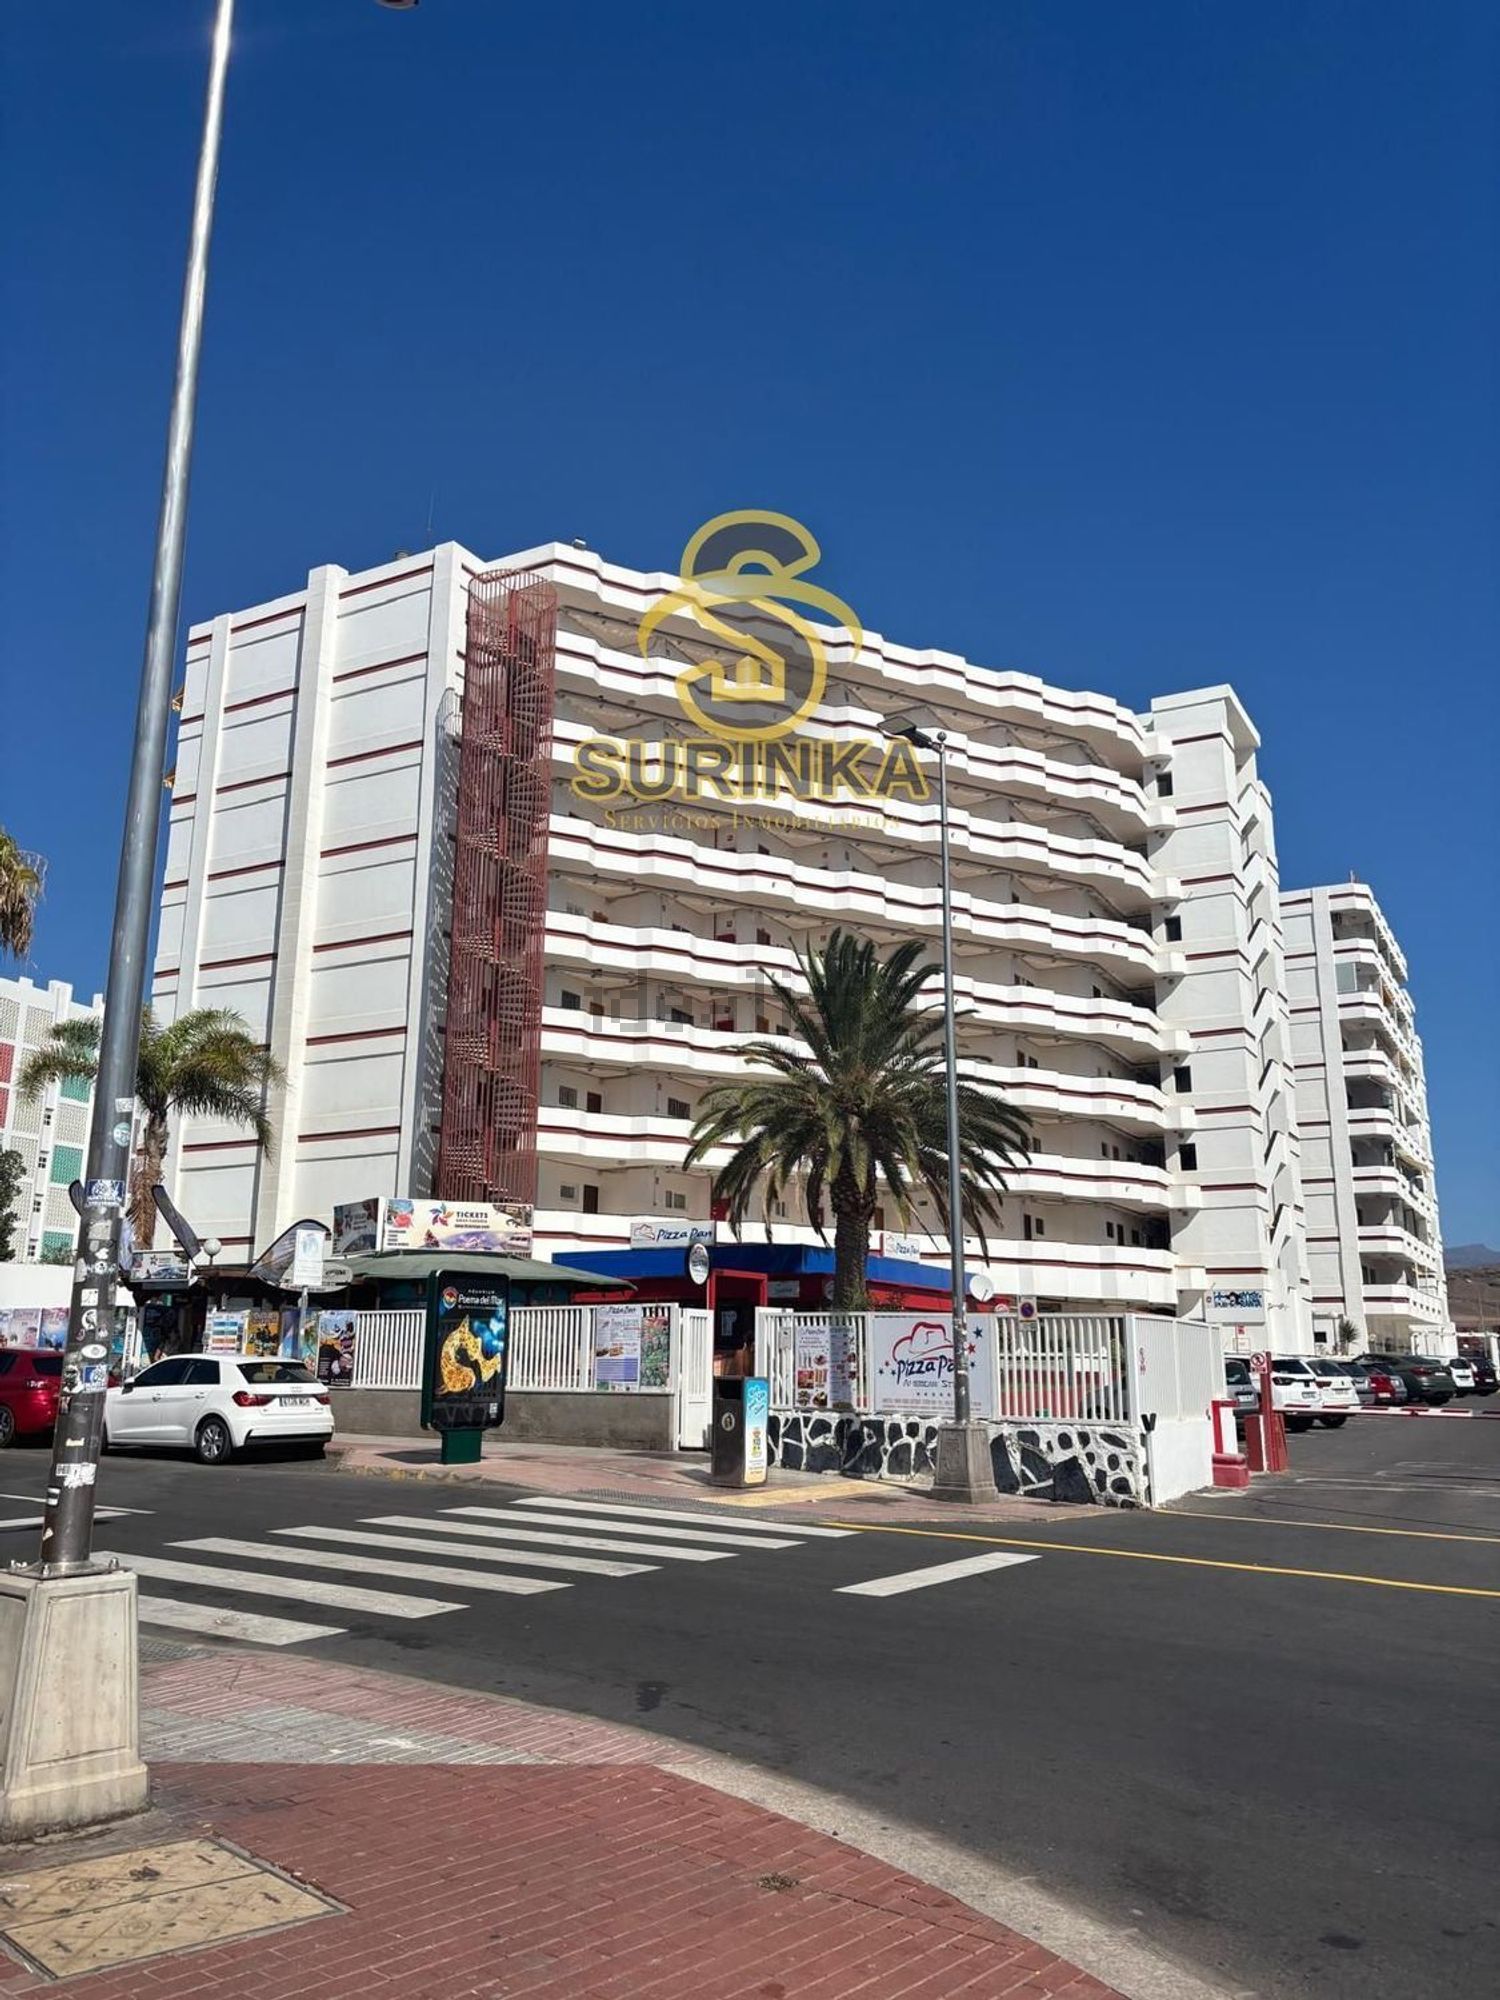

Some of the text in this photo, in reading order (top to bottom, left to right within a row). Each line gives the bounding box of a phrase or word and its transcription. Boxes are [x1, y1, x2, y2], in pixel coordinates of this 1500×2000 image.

[456, 1211, 489, 1219] TICKETS
[656, 1228, 712, 1242] Pizza Pan
[458, 1294, 480, 1304] Poema
[480, 1295, 490, 1305] del
[897, 1355, 956, 1385] Pizza Pa
